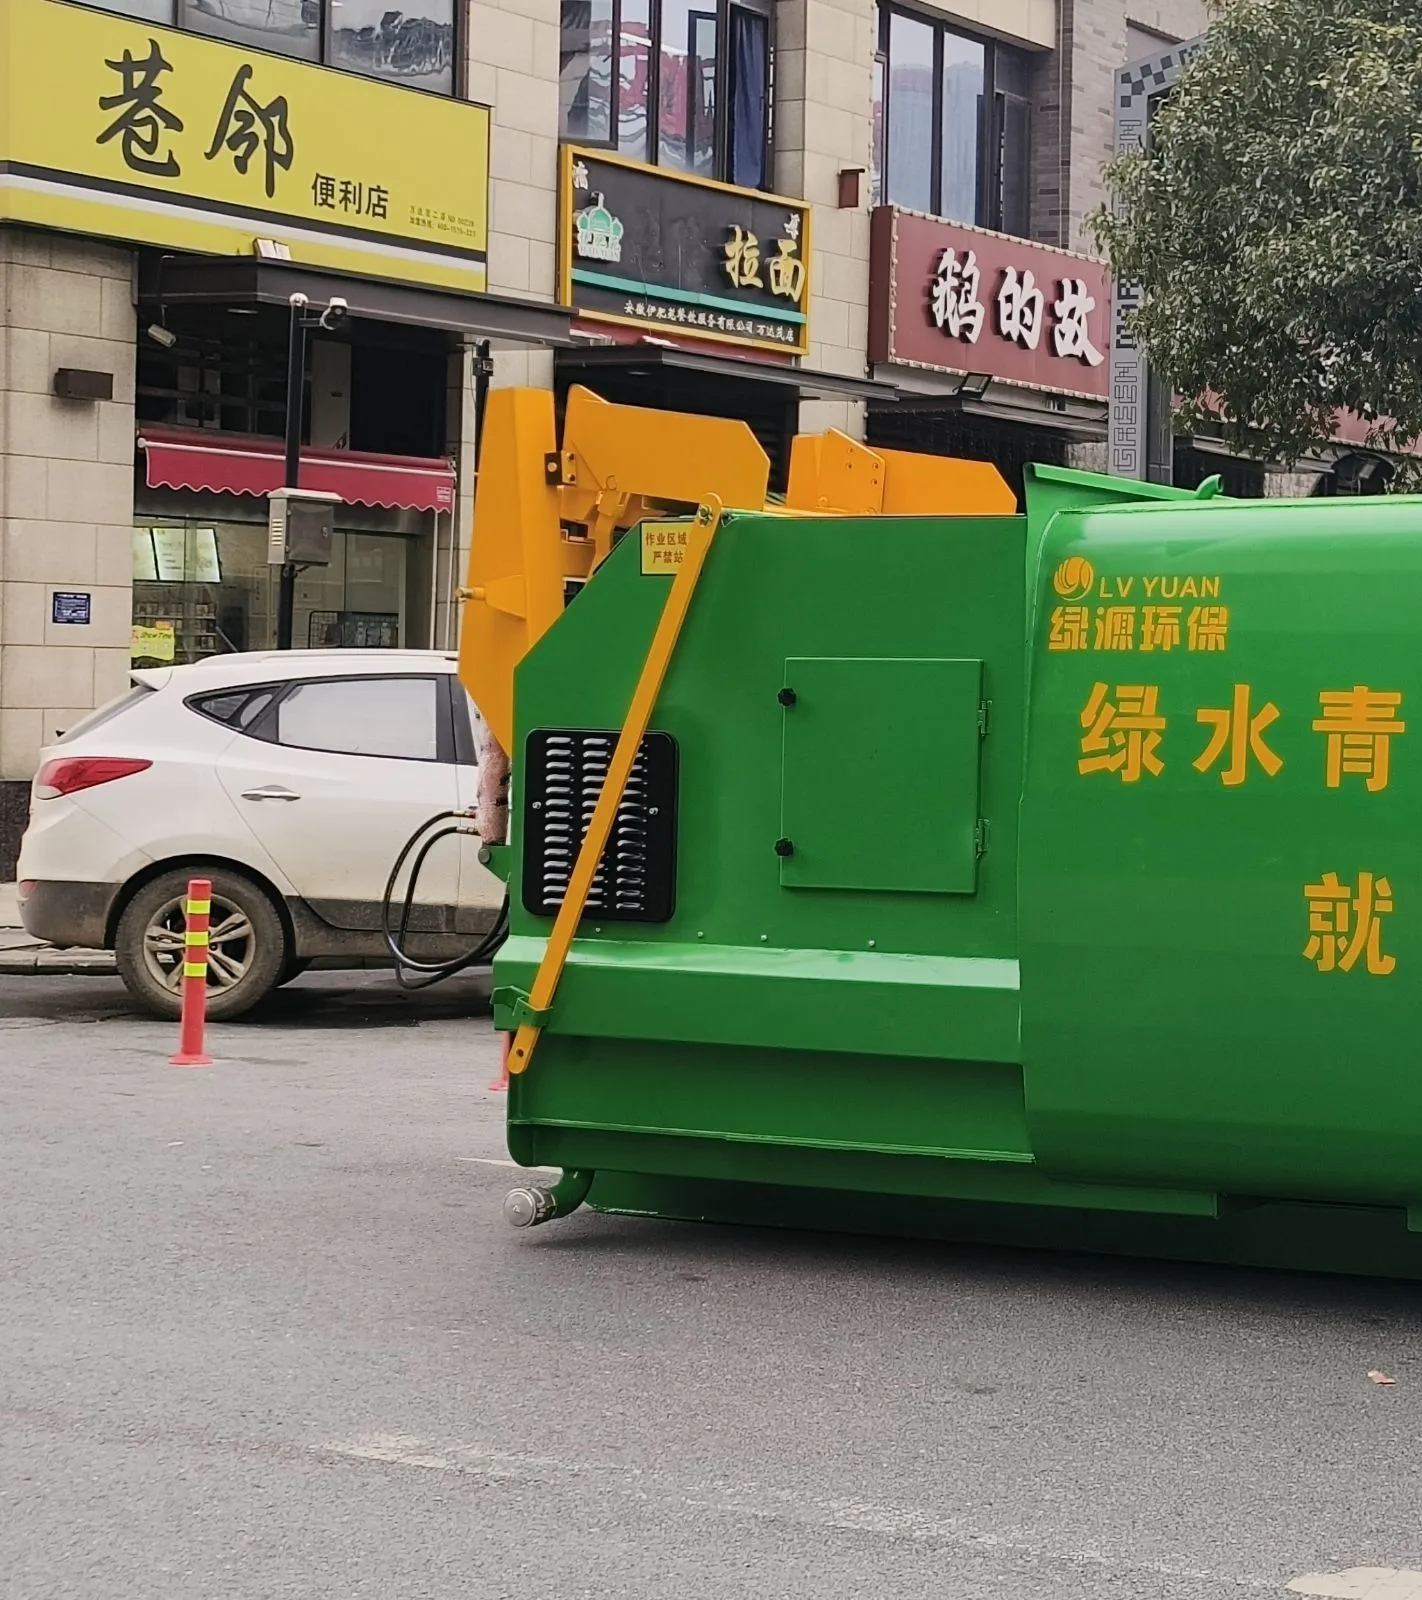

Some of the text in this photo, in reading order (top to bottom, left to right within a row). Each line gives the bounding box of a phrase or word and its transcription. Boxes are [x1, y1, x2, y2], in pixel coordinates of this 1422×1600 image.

[96, 38, 294, 198] 巷邻
[311, 172, 389, 220] 便利店
[724, 223, 806, 302] 拉面
[932, 247, 1105, 367] 鹅的故
[1113, 277, 1141, 473] GREEN MAR
[645, 531, 688, 546] 作业区域
[653, 550, 684, 564] 严禁站
[1099, 575, 1220, 599] LV YUAN
[1048, 606, 1229, 651] 绿源环保
